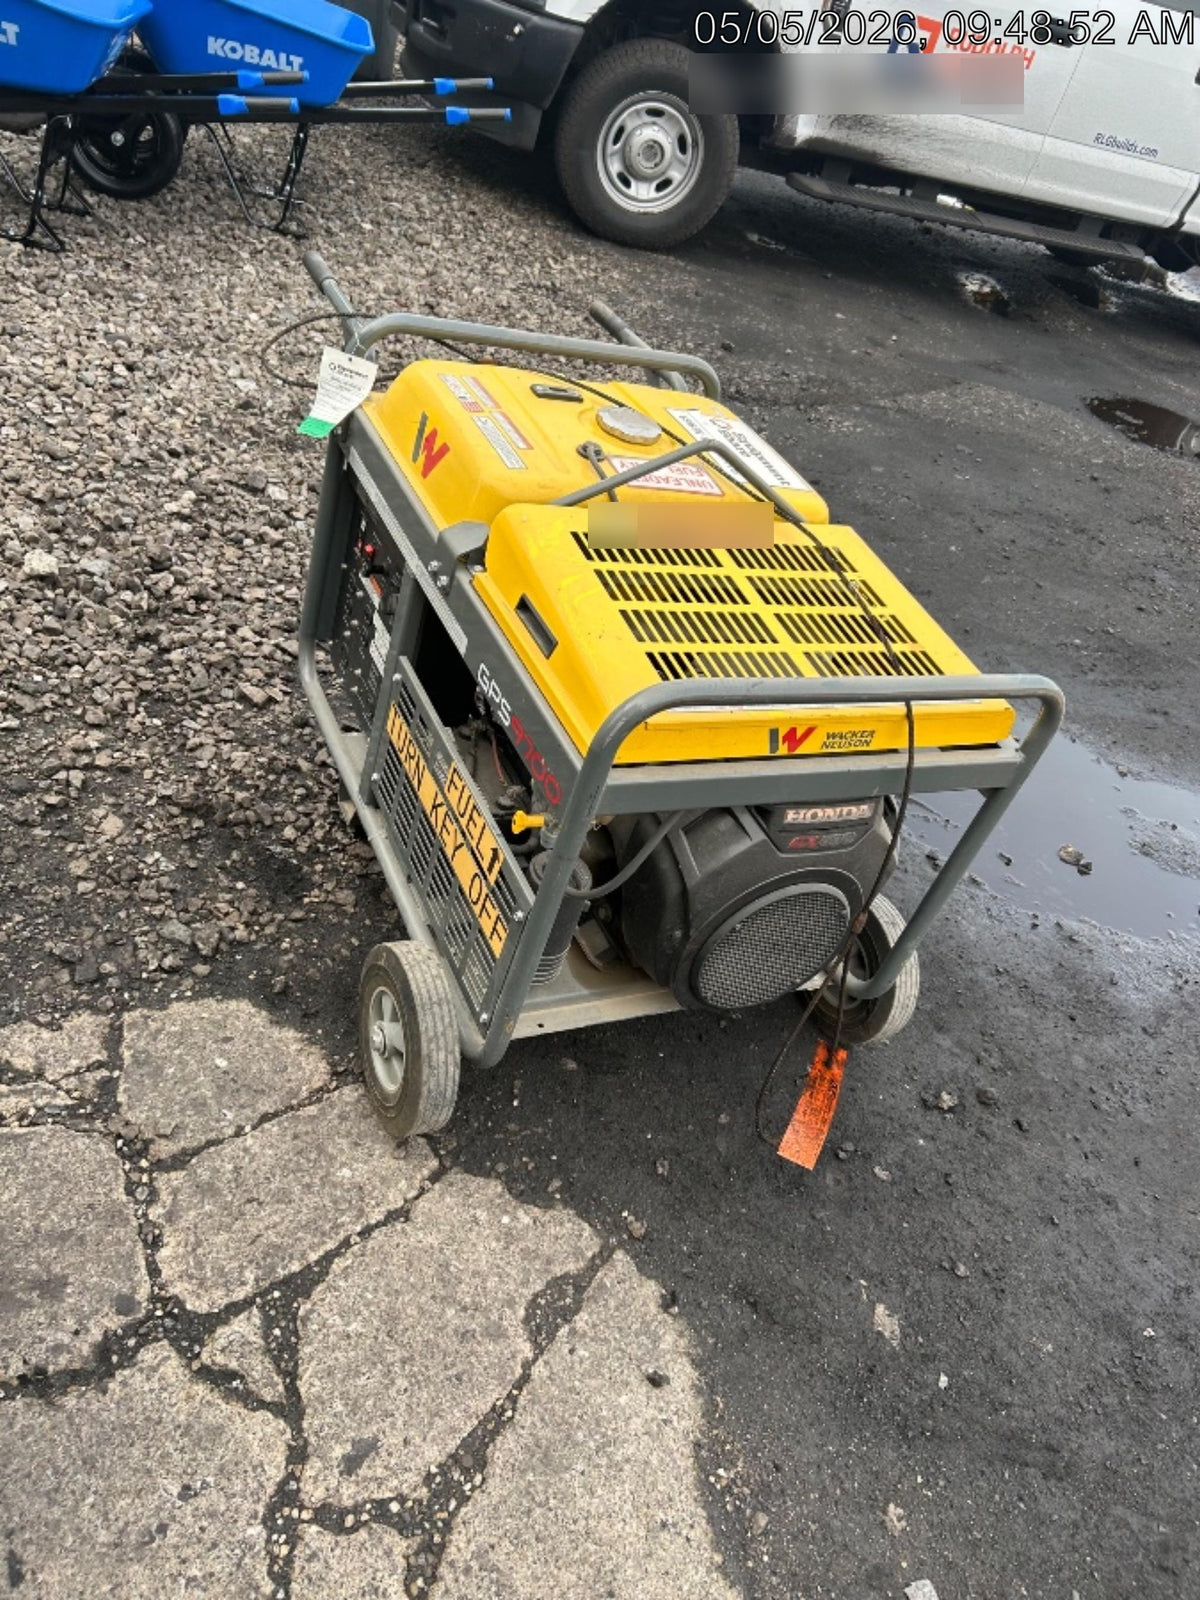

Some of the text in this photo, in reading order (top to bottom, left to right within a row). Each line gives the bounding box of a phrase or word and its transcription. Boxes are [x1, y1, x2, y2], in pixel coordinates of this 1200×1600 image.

[207, 35, 304, 72] KOBALT
[820, 739, 872, 750] NEUSON
[826, 730, 876, 741] WACKER
[391, 703, 425, 791] TURN
[430, 791, 465, 862] KEY
[469, 872, 509, 940] OFF
[448, 767, 486, 861] FUEL
[784, 804, 875, 823] HONDA
